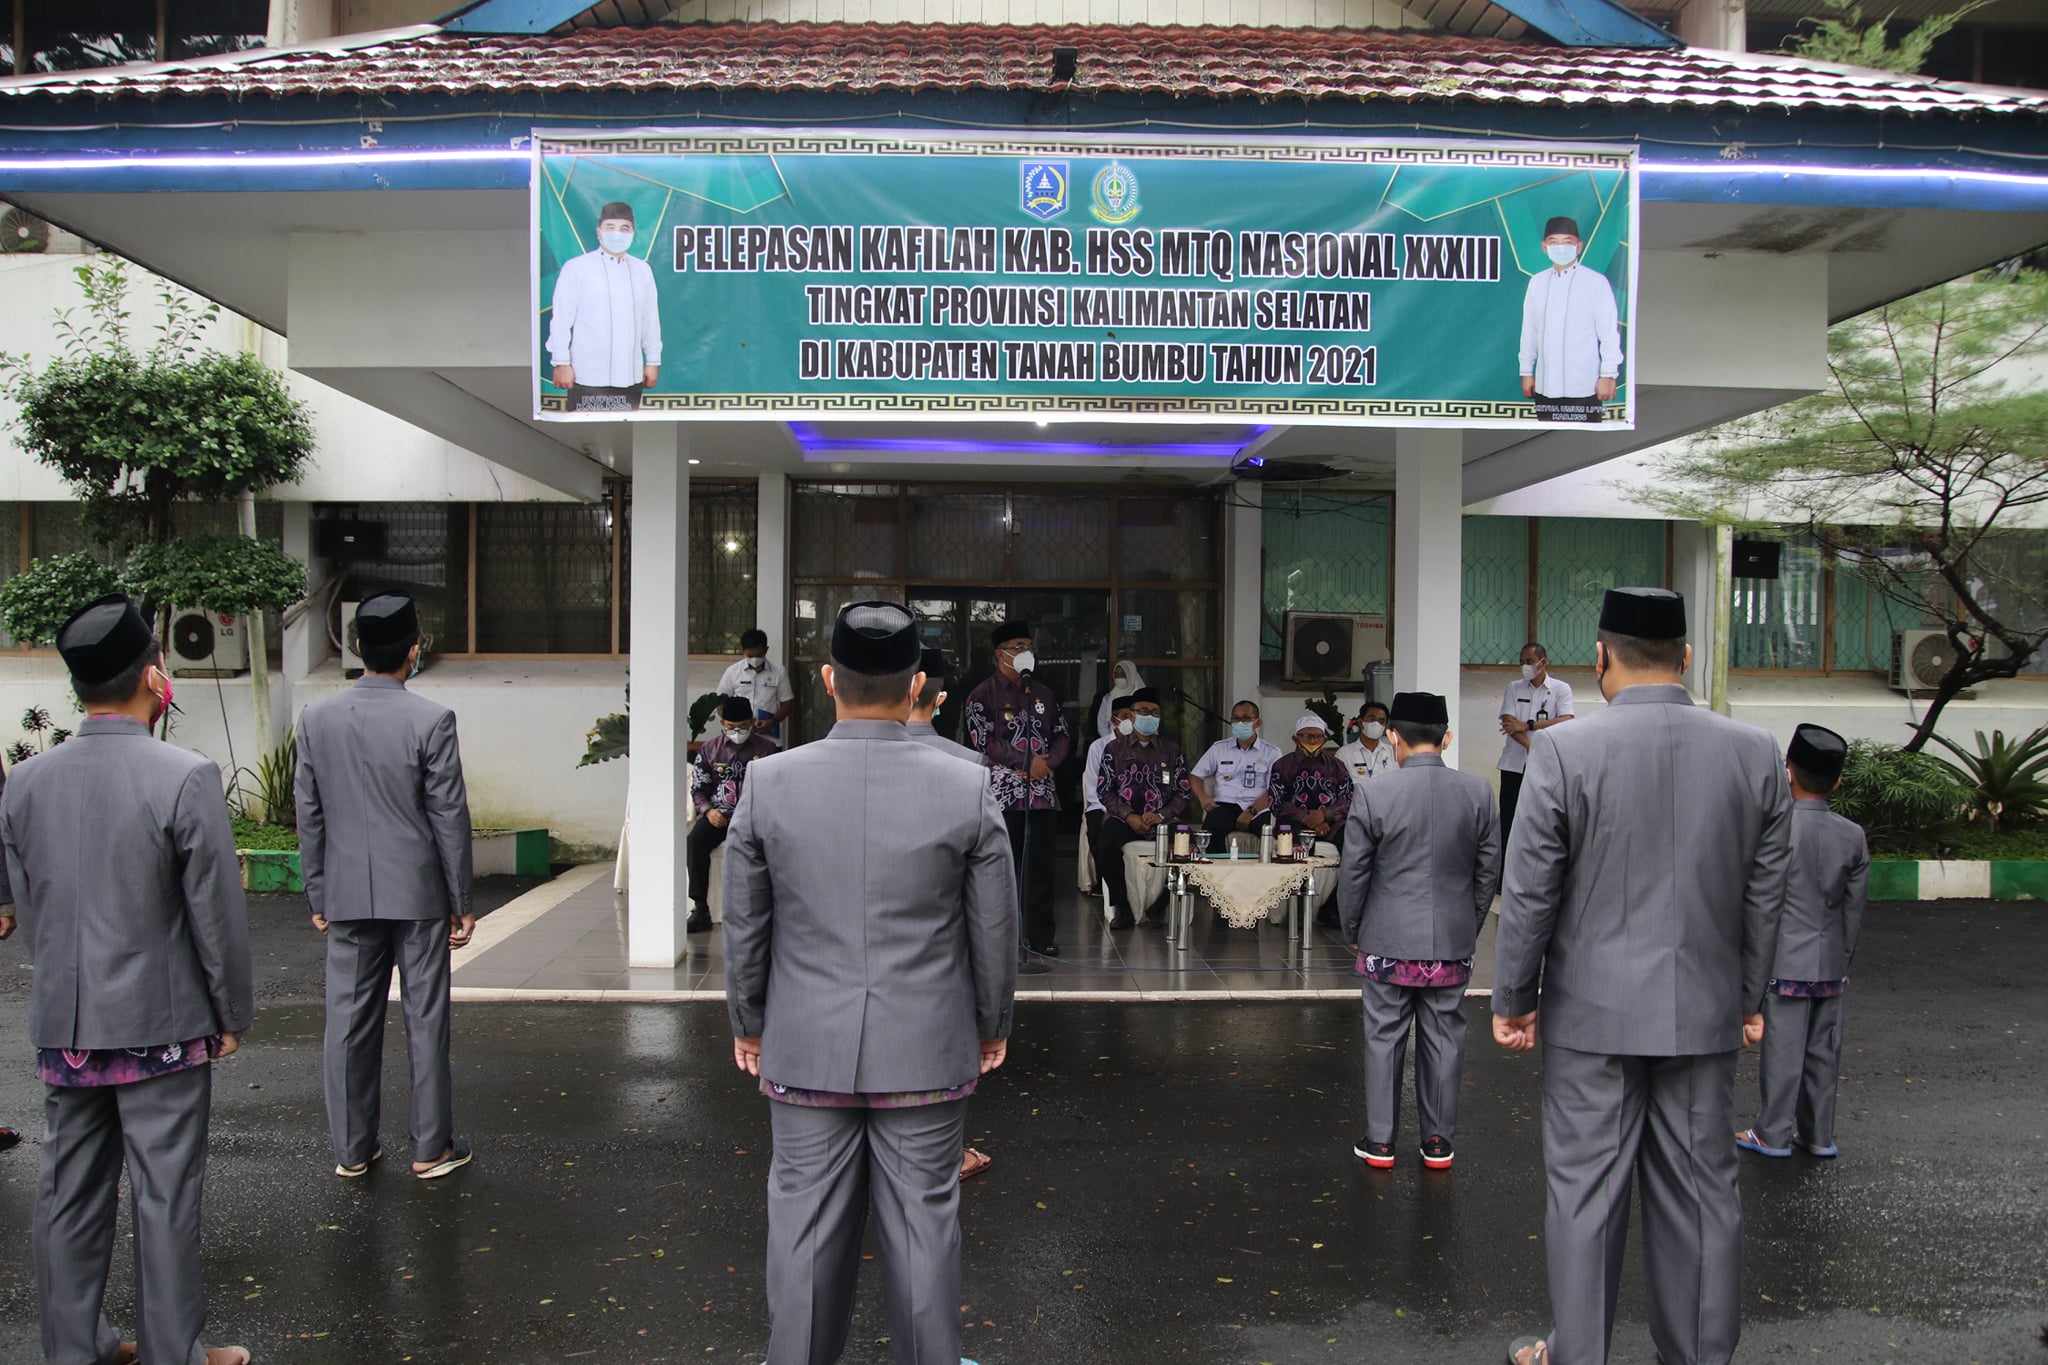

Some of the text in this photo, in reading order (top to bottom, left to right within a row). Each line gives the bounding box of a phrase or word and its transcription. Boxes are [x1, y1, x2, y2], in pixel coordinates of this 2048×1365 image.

[674, 225, 1501, 282] PELEPASAN KAFILAH KAB. HSS MTQ NASIONAL XXXIII
[805, 285, 1371, 331] TINGKAT PROVINSI KALIMANTAN SELATAN
[798, 340, 1377, 386] DI KABUPATEN TANAH BUMBU TAHUN 2021
[221, 628, 234, 636] LG
